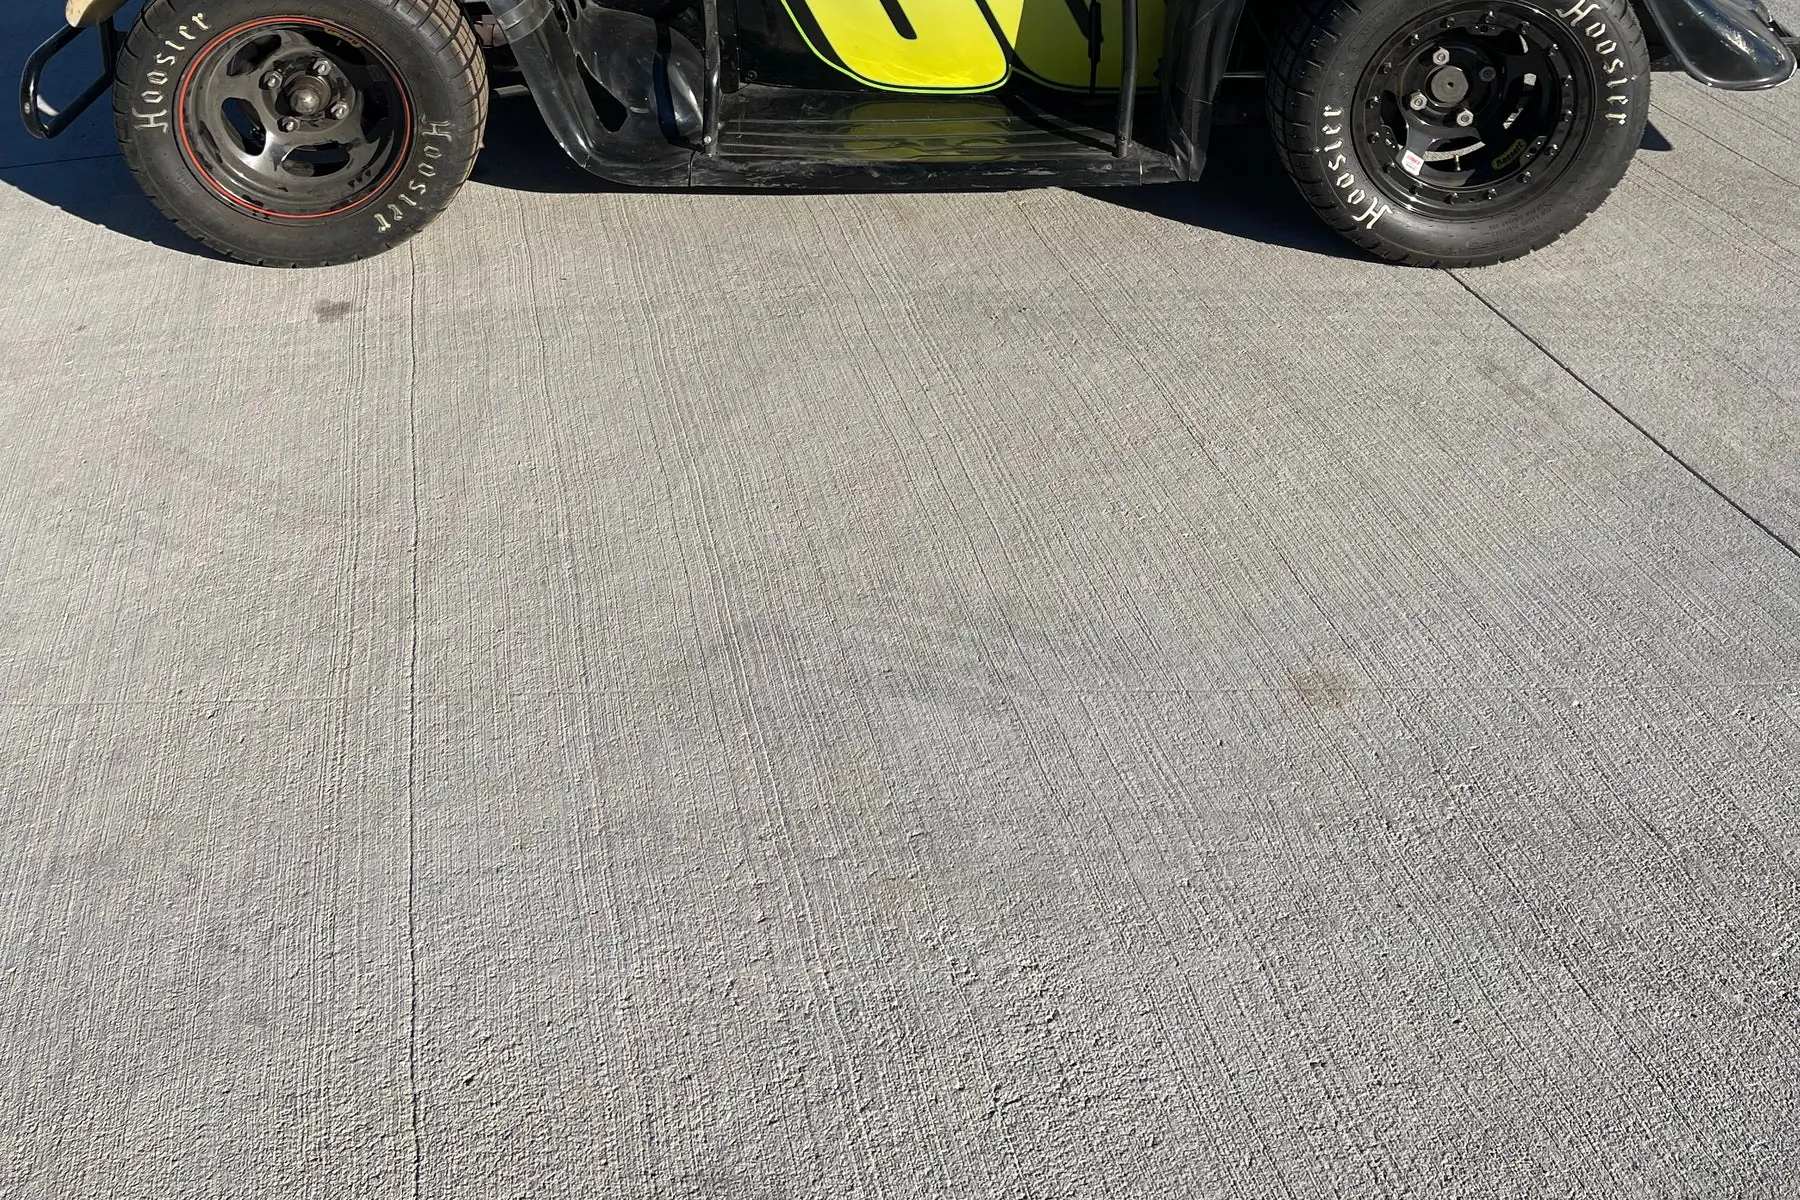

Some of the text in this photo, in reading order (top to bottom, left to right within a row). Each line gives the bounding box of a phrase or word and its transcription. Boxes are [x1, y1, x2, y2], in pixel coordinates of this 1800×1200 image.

[132, 13, 211, 134] Hoosier
[373, 113, 452, 233] Hoosier
[1315, 105, 1393, 230] Hoosier
